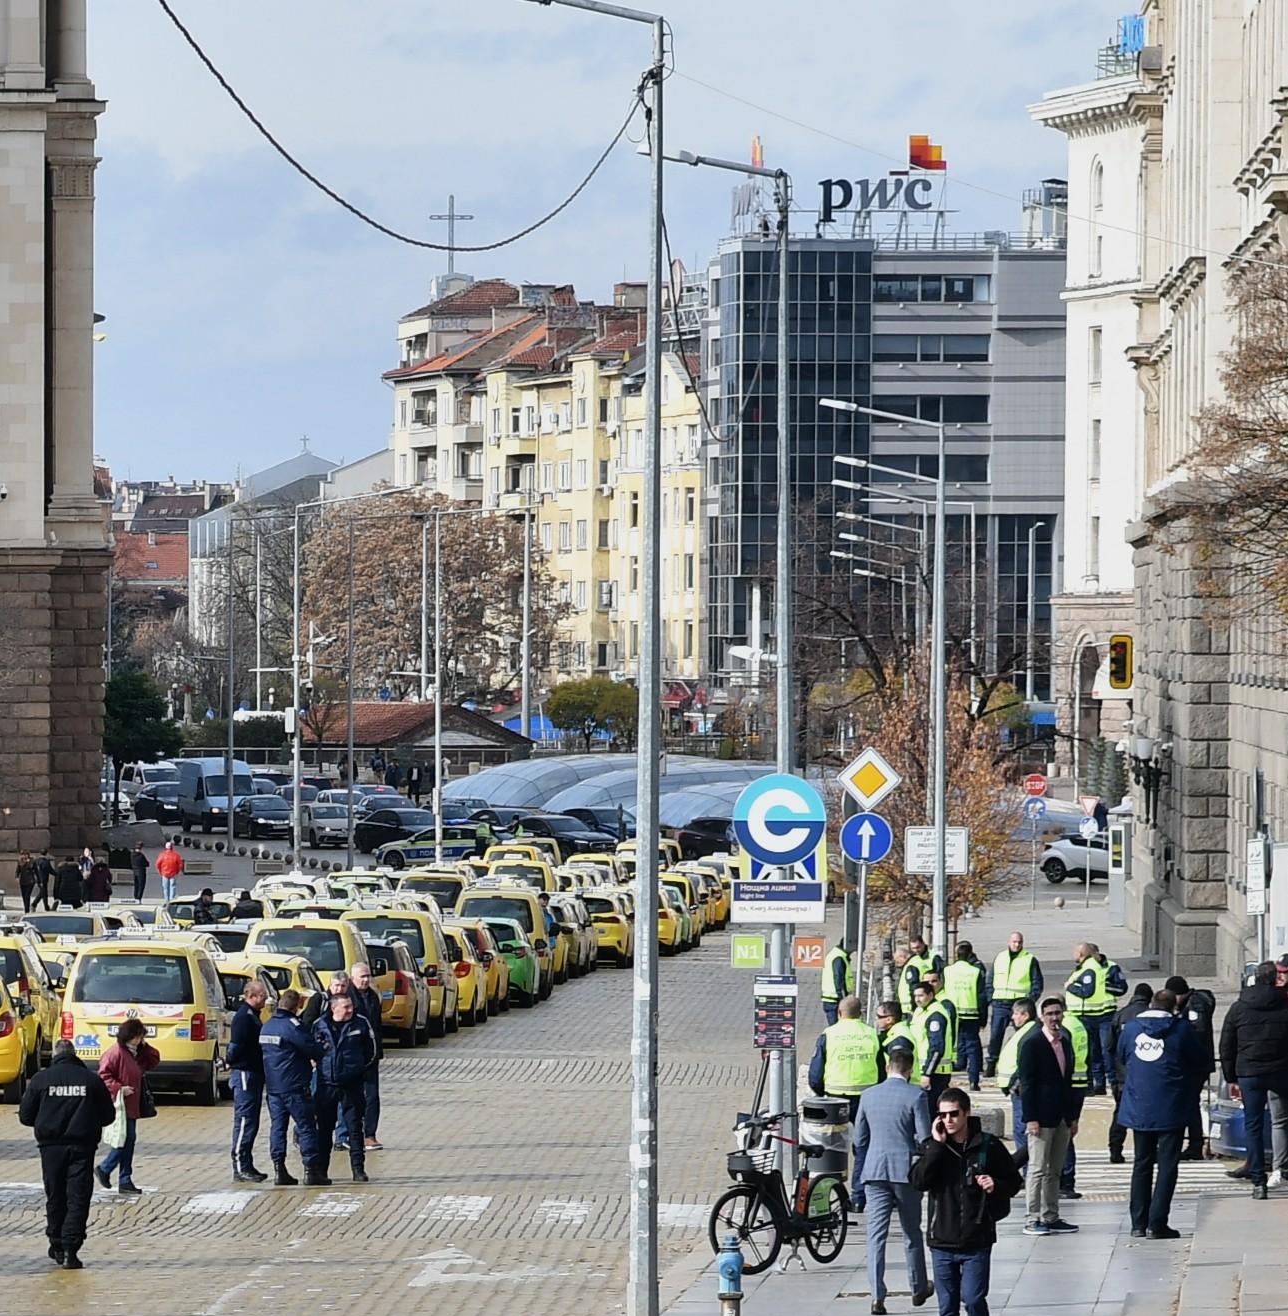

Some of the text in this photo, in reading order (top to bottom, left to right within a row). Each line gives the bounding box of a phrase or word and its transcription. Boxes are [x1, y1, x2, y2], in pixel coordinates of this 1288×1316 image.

[818, 177, 932, 222] pwc
[739, 883, 769, 892] Нощна
[736, 944, 760, 959] N1
[797, 944, 822, 960] N2
[75, 1034, 100, 1048] OK
[49, 1086, 86, 1097] POLICE
